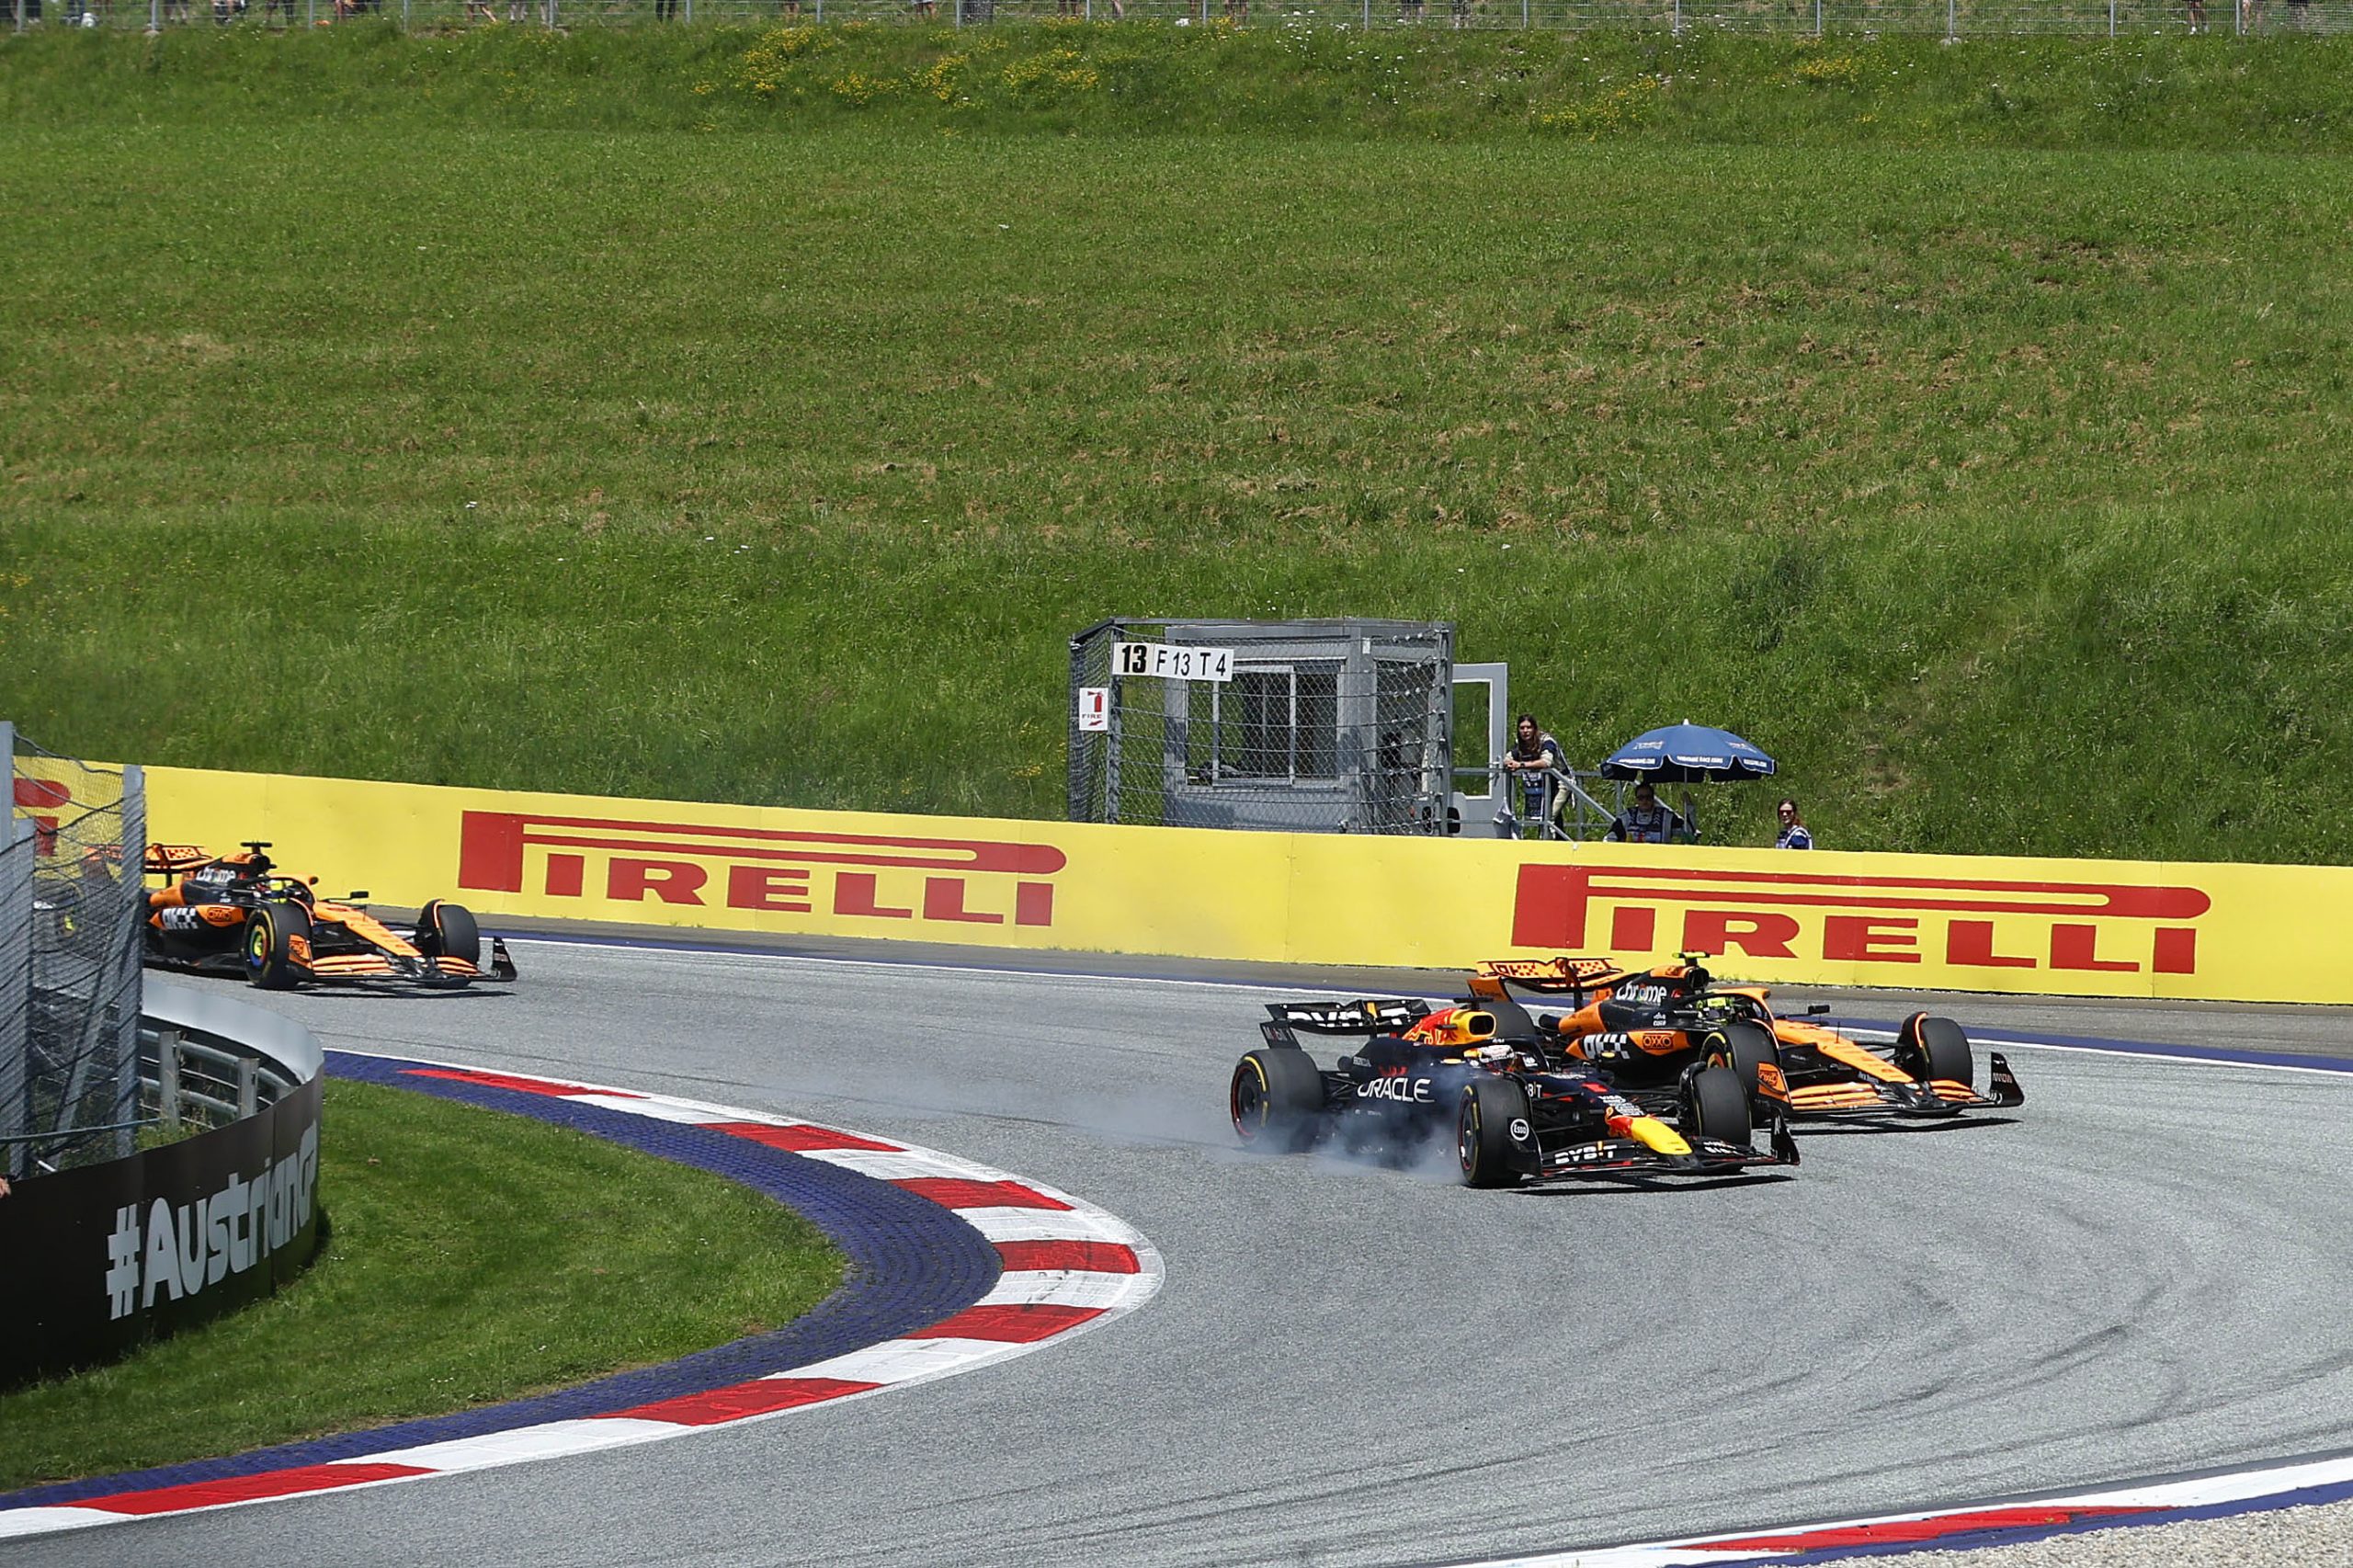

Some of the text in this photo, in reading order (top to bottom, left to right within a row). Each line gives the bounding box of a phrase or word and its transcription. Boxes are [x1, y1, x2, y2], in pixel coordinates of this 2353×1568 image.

[1121, 644, 1226, 676] 13 F 13 T 4
[458, 810, 1067, 927] PIRELLI
[1510, 863, 2211, 974] PIRELLI
[1616, 981, 1667, 1005] chrome
[1643, 1036, 1672, 1048] OXXO
[1357, 1077, 1436, 1103] ORACLE
